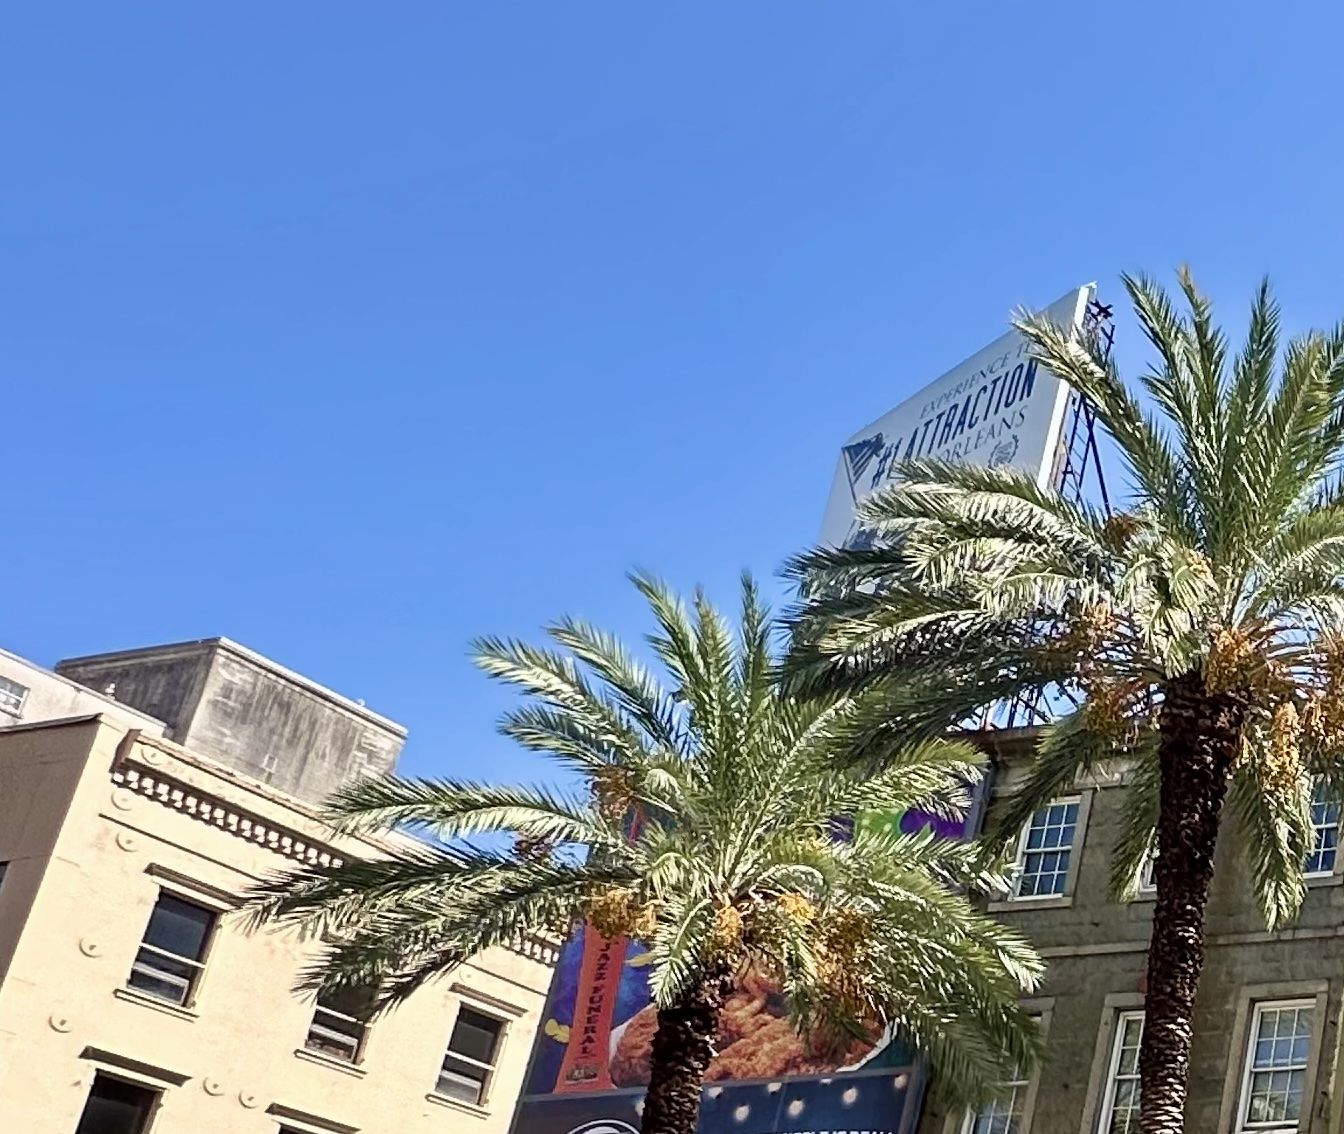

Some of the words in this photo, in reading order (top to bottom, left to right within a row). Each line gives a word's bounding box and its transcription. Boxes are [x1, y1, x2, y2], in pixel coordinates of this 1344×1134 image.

[903, 357, 1039, 461] ATTRACTION
[920, 352, 1012, 419] EXPERIENCE
[580, 984, 604, 1055] FUNERAL
